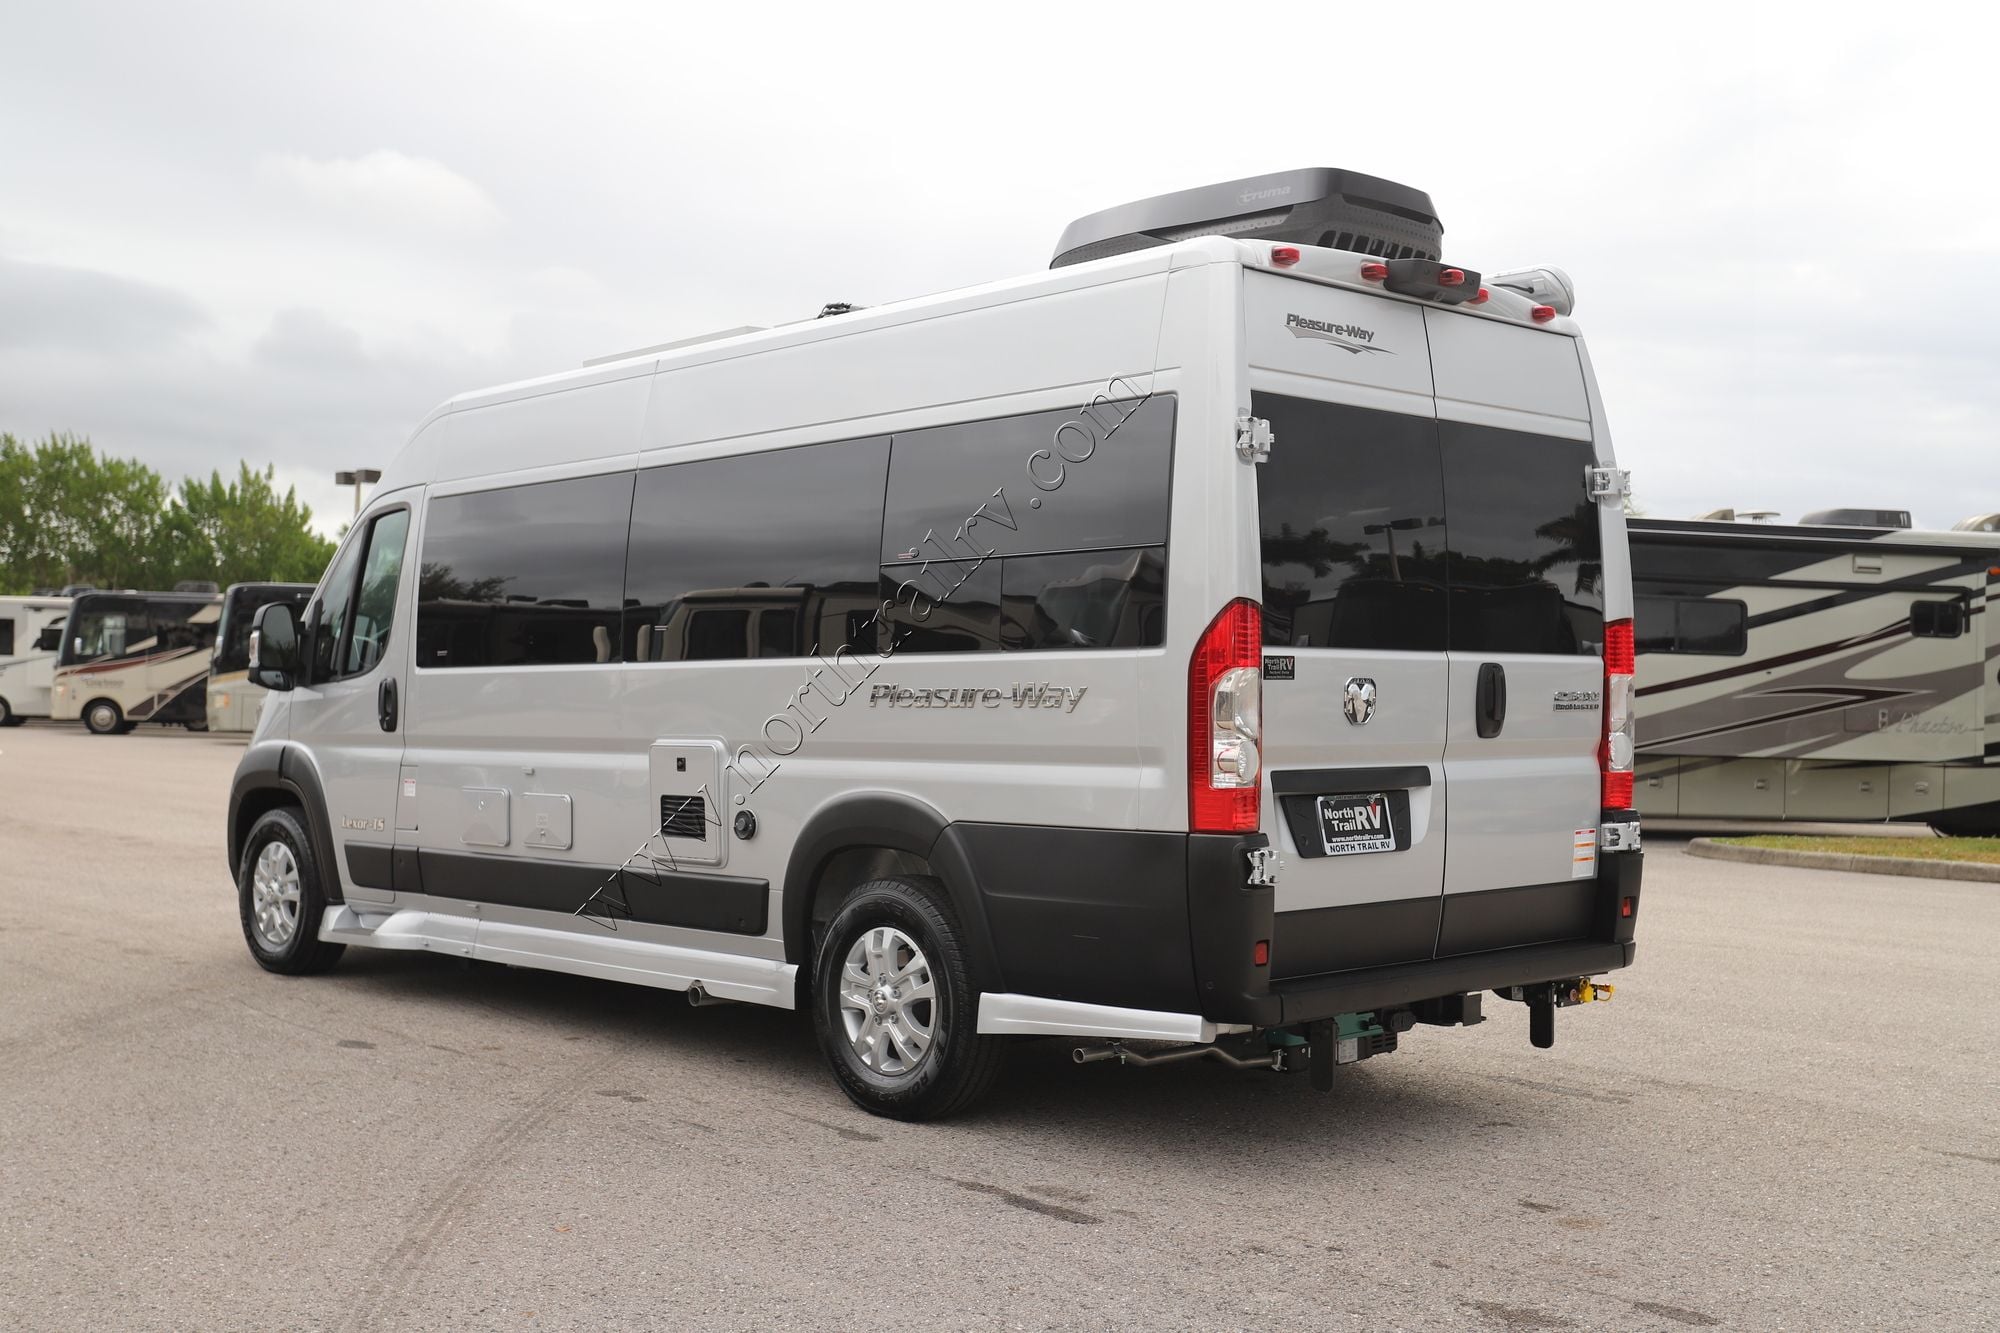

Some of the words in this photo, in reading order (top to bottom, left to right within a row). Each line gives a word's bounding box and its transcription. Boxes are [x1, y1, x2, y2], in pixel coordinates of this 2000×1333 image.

[1240, 185, 1292, 202] truma
[1286, 313, 1375, 342] Pleasure-Way
[869, 681, 1088, 714] Pleasure-Way
[1324, 808, 1354, 819] North
[1354, 806, 1381, 830] RV
[1332, 820, 1357, 831] Trail
[1330, 844, 1356, 853] NORTH
[1357, 842, 1379, 850] TRAIL
